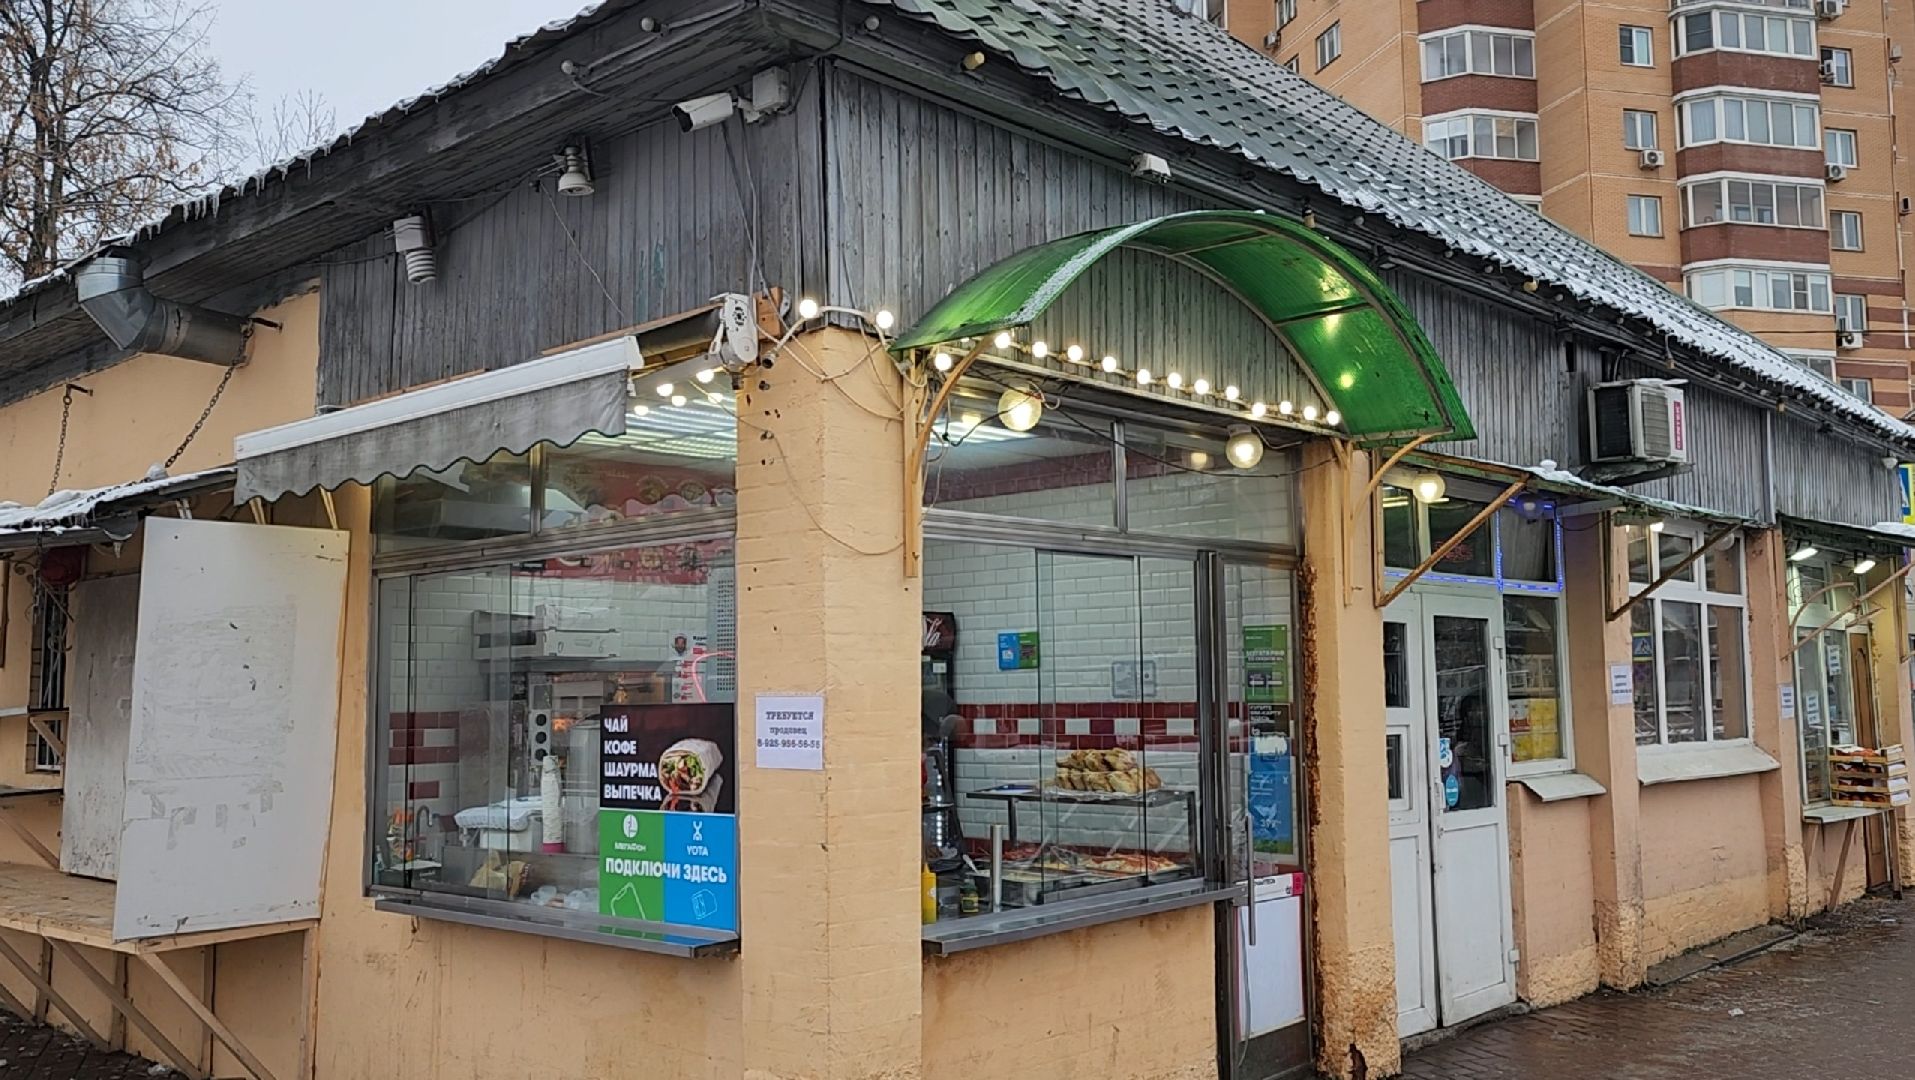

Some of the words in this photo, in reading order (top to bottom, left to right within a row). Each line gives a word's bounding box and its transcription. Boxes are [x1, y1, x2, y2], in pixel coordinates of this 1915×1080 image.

[766, 711, 814, 720] ТРЕБУЕТСЯ
[604, 715, 628, 733] ЧАЙ
[769, 727, 808, 736] продавец
[604, 740, 637, 755] КОФЕ
[604, 761, 658, 778] ШАУРМА
[603, 783, 662, 801] ВЫПЕЧКА
[686, 845, 709, 857] YOTA
[605, 857, 681, 879] ПОДКЛЮЧИ
[683, 863, 727, 883] ЗДЕСЬ
